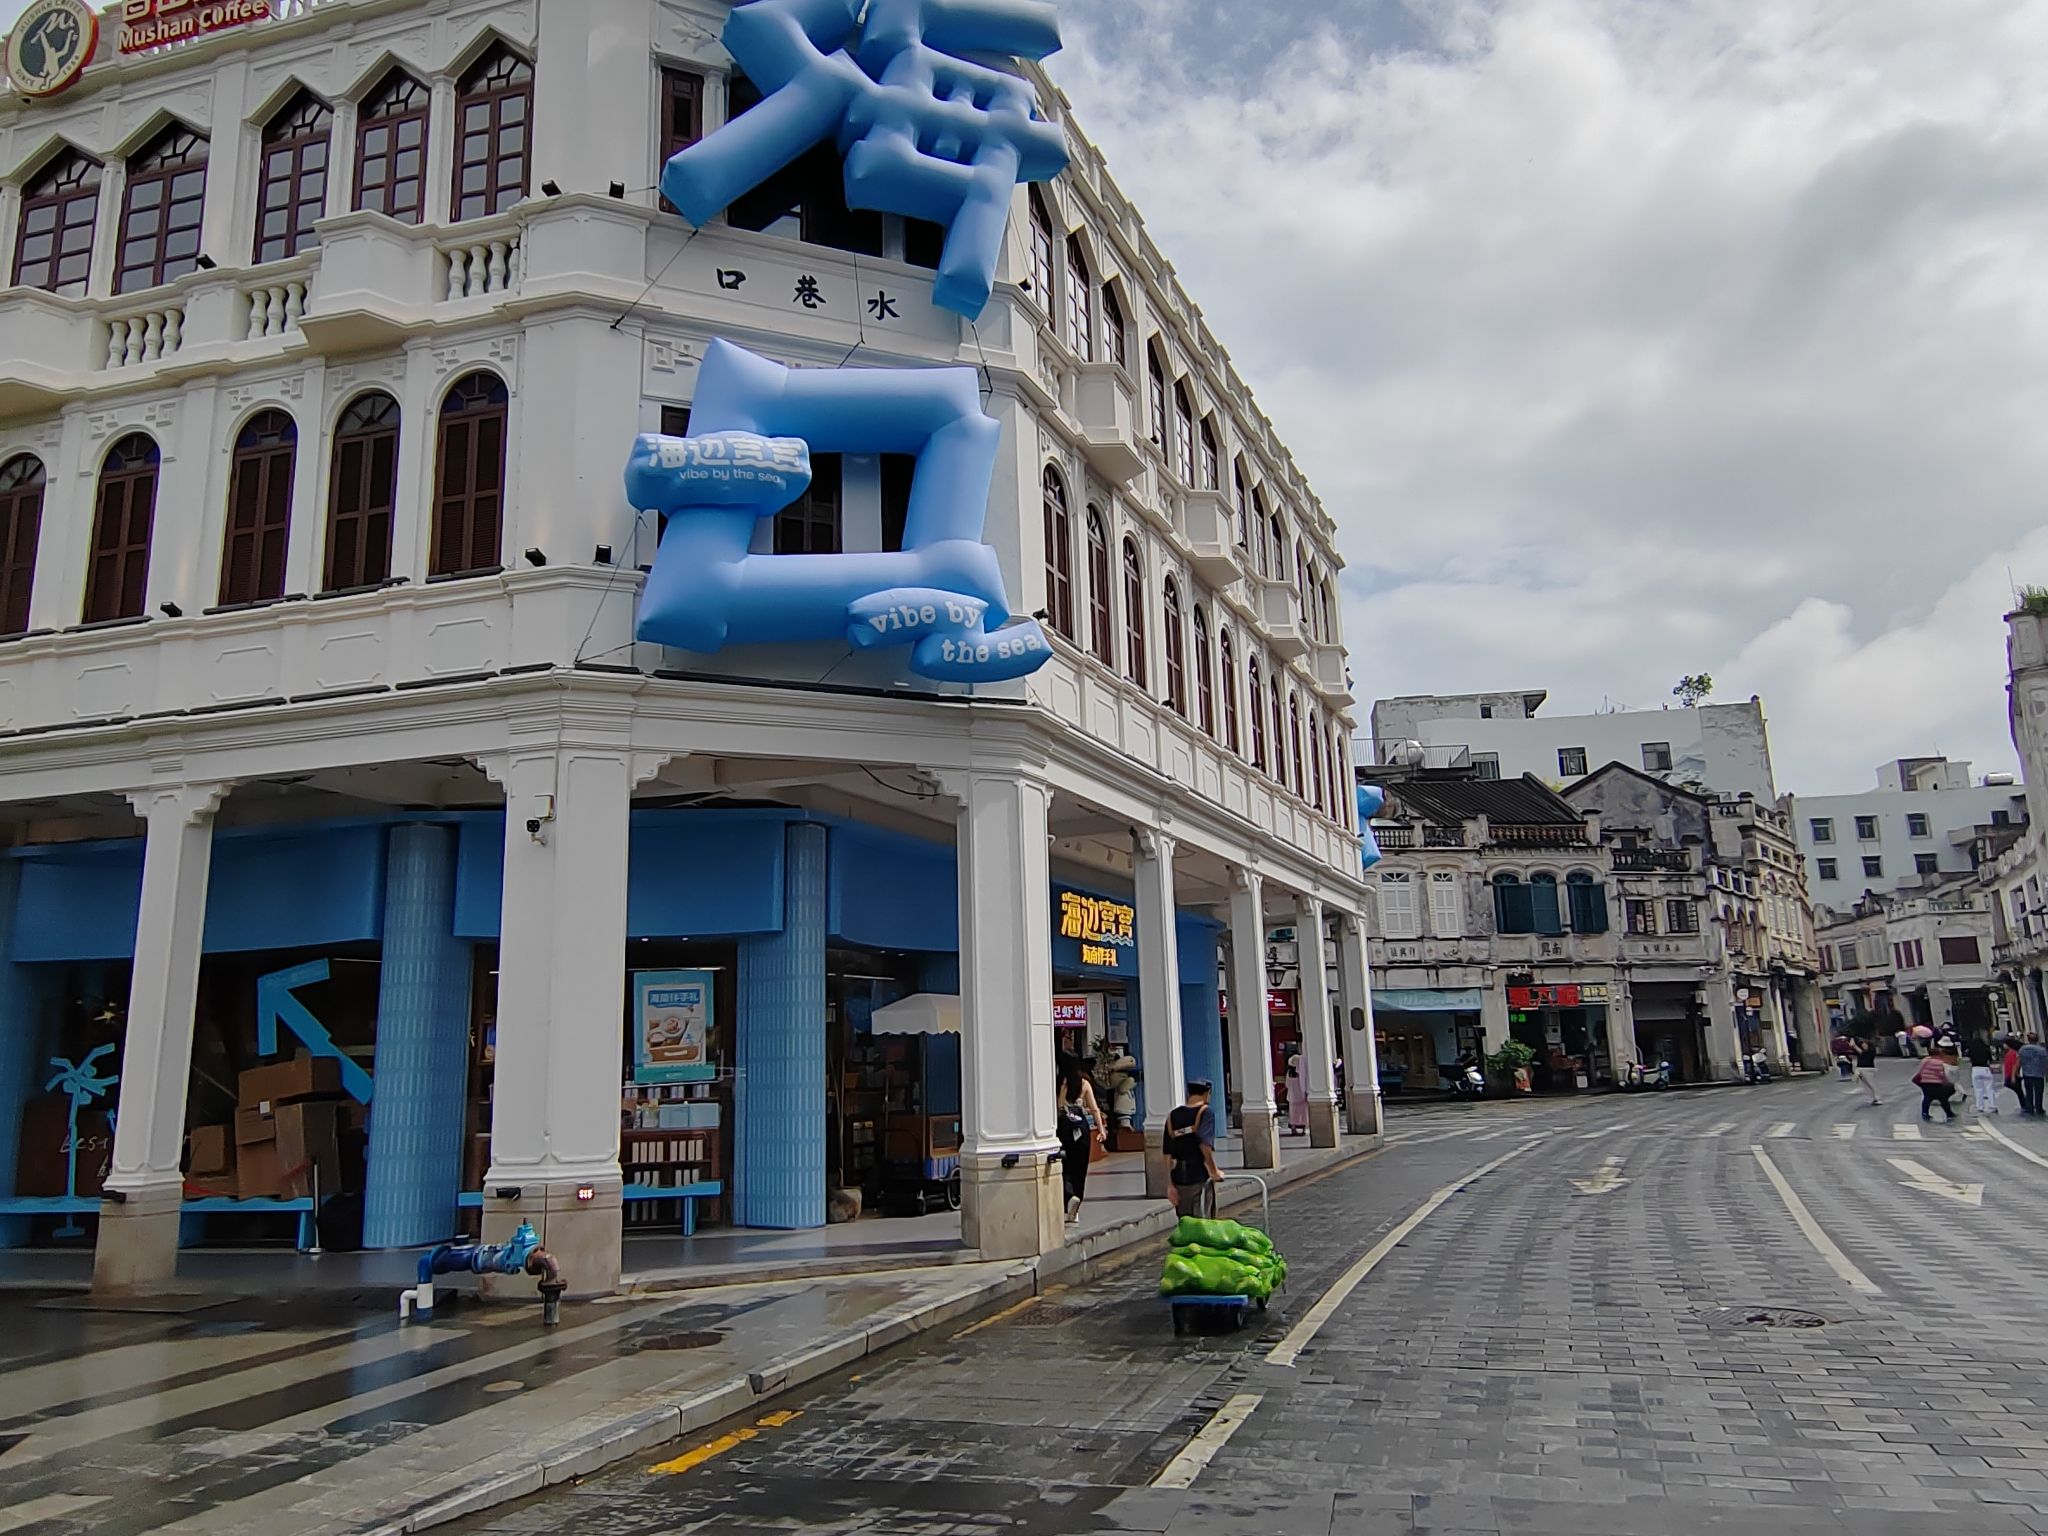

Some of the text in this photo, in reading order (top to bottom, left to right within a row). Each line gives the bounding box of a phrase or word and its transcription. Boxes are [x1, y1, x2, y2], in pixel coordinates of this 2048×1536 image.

[118, 16, 194, 50] Mushan
[200, 0, 265, 28] Coffee
[679, 468, 709, 480] vibe
[712, 469, 730, 481] by
[733, 469, 755, 480] the
[868, 600, 982, 634] vibe by
[942, 634, 1042, 664] the sea
